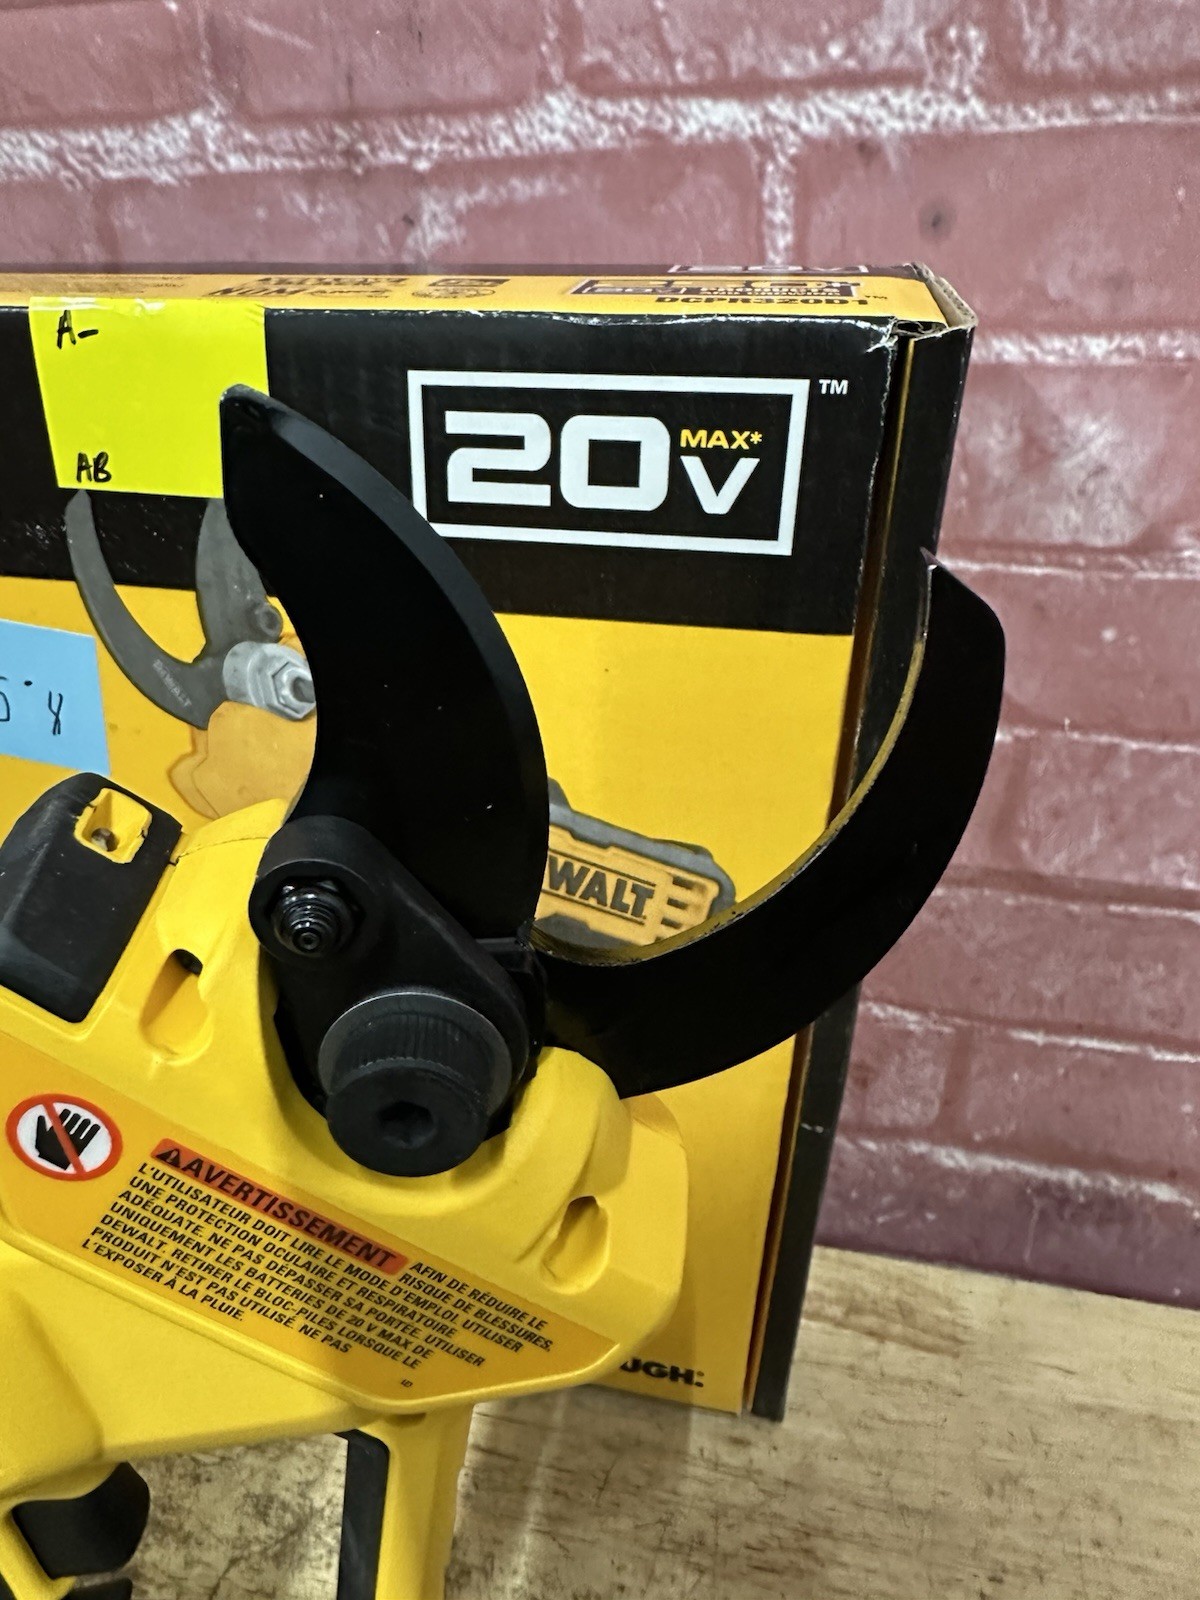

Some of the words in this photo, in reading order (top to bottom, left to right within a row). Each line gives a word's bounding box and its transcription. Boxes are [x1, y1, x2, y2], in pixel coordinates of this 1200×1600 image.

[656, 297, 868, 305] DCPR320D1
[819, 379, 849, 395] TM
[76, 451, 112, 483] AB
[548, 856, 654, 918] WALT
[130, 1176, 165, 1199] UNE
[165, 1194, 263, 1246] PROTECTION
[263, 1242, 337, 1282] OCULAIRE
[336, 1277, 358, 1290] ET
[356, 1286, 457, 1338] RESPIRATOIRE
[138, 1163, 252, 1224] L'UTILISATEUR
[252, 1219, 291, 1242] DOIT
[290, 1238, 325, 1259] LIRE
[324, 1254, 344, 1269] LE
[343, 1263, 391, 1291] MODE
[462, 1319, 523, 1352] UTILISER
[181, 1158, 398, 1268] AVERTISSEMENT
[82, 1239, 164, 1282] L'EXPOSER
[164, 1276, 176, 1289] À
[178, 1285, 198, 1299] LA
[201, 1294, 244, 1321] PLUIE.
[91, 1227, 161, 1263] PRODUIT
[160, 1260, 206, 1285] N'EST
[206, 1281, 238, 1301] PAS
[299, 1324, 322, 1339] NE
[321, 1334, 352, 1353] PAS
[101, 1215, 167, 1253] DEWALT.
[171, 1248, 233, 1283] RETIRER
[234, 1278, 254, 1292] LE
[254, 1287, 337, 1331] BLOC-PILES
[337, 1327, 403, 1361] LORSQUE
[402, 1356, 421, 1369] LE
[110, 1202, 216, 1257] UNIQUEMENT
[215, 1253, 244, 1271] LES
[245, 1267, 325, 1309] BATTERIES
[325, 1305, 347, 1319] DE
[346, 1315, 365, 1327] 20
[366, 1323, 378, 1332] V
[377, 1329, 413, 1350] MAX
[412, 1345, 433, 1359] DE
[118, 1191, 204, 1237] ADÉQUATE.
[208, 1232, 232, 1249] NE
[232, 1244, 265, 1264] PAS
[265, 1260, 343, 1301] DÉPASSER
[343, 1297, 364, 1312] SA
[424, 1334, 485, 1366] UTILISER
[399, 1273, 454, 1304] RISQUE
[452, 1298, 475, 1314] DE
[473, 1309, 553, 1352] BLESSURES,
[409, 1262, 447, 1283] AFIN
[444, 1276, 469, 1294] DE
[467, 1289, 529, 1322] RÉDUIRE
[527, 1317, 547, 1330] LE
